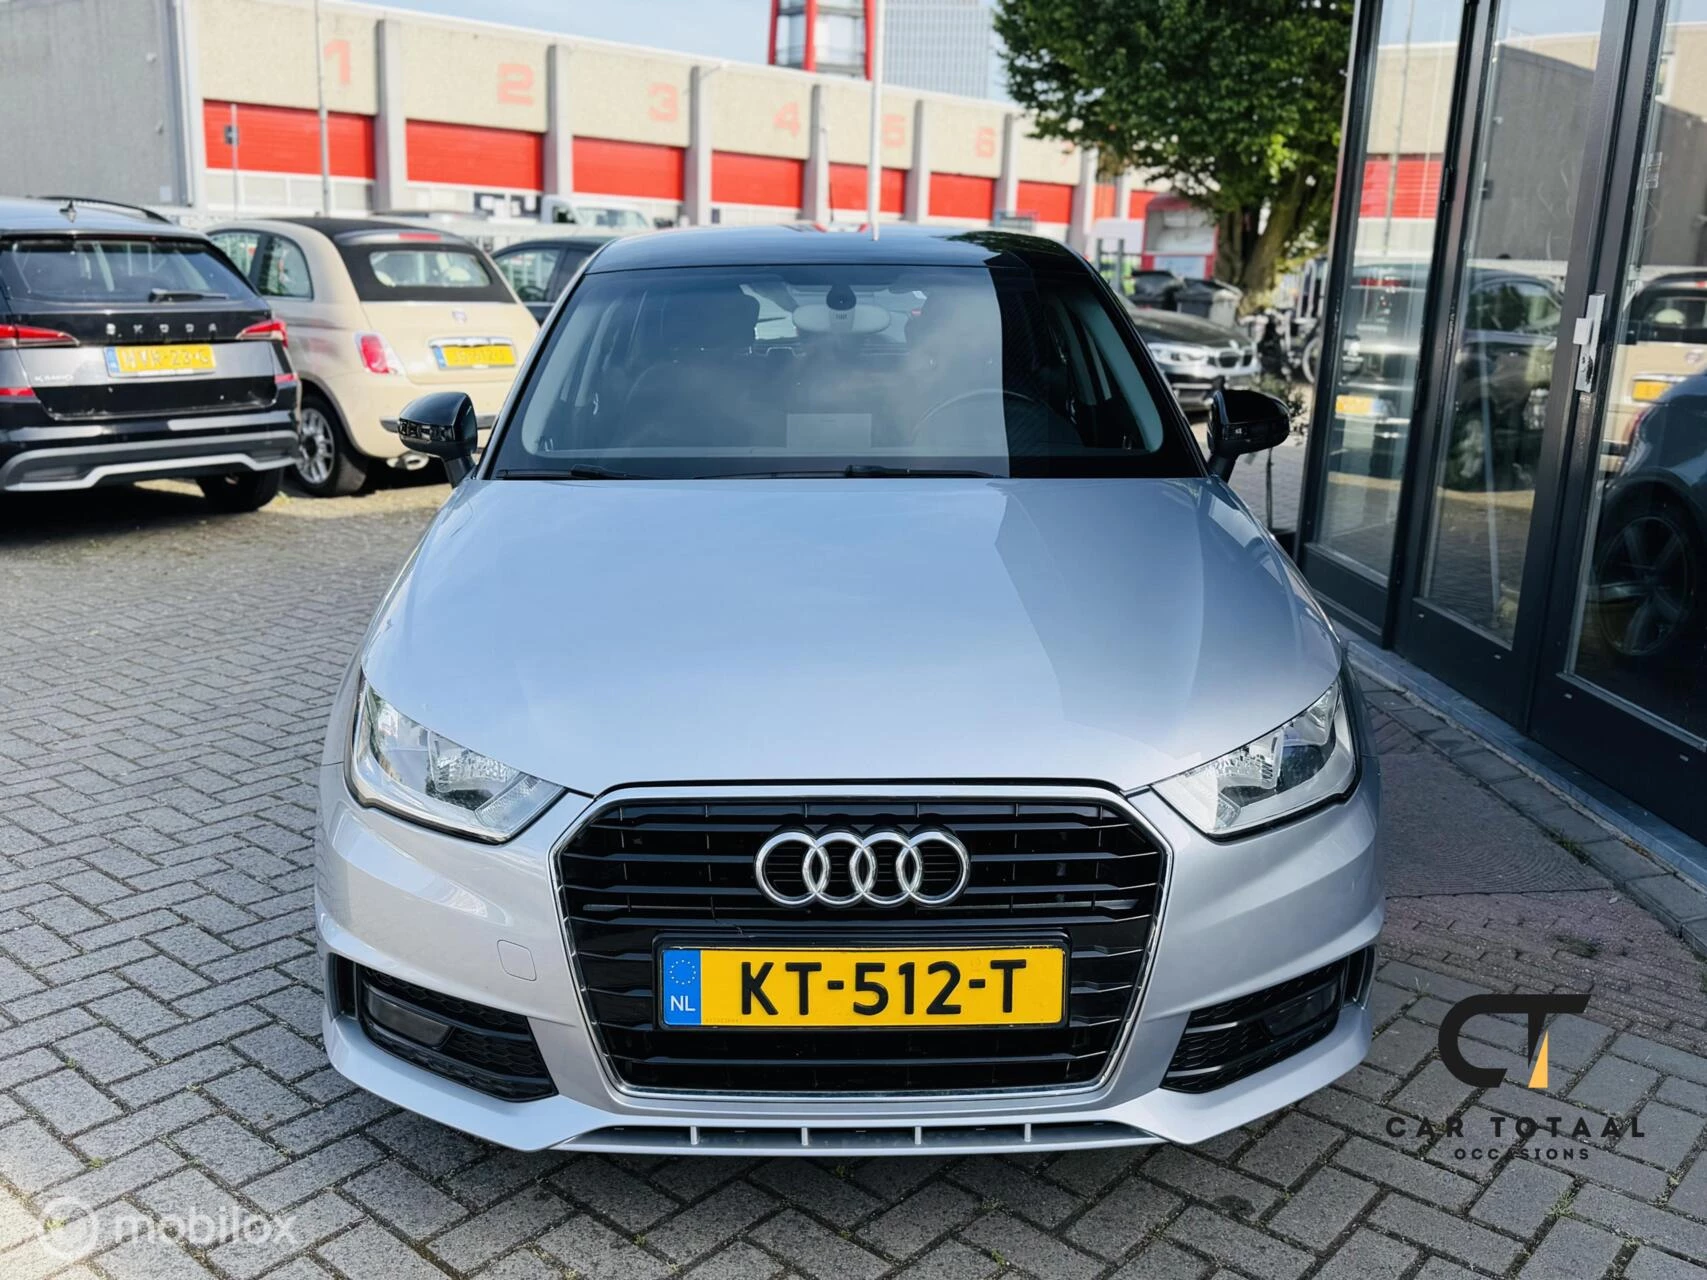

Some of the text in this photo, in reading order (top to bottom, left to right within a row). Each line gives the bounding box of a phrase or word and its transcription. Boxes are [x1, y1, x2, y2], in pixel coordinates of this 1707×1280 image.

[323, 39, 351, 86] 1
[497, 62, 535, 106] 2
[648, 82, 679, 122] 3
[772, 101, 801, 137] 4
[670, 995, 696, 1012] NL
[741, 959, 1027, 1016] KT-512-T
